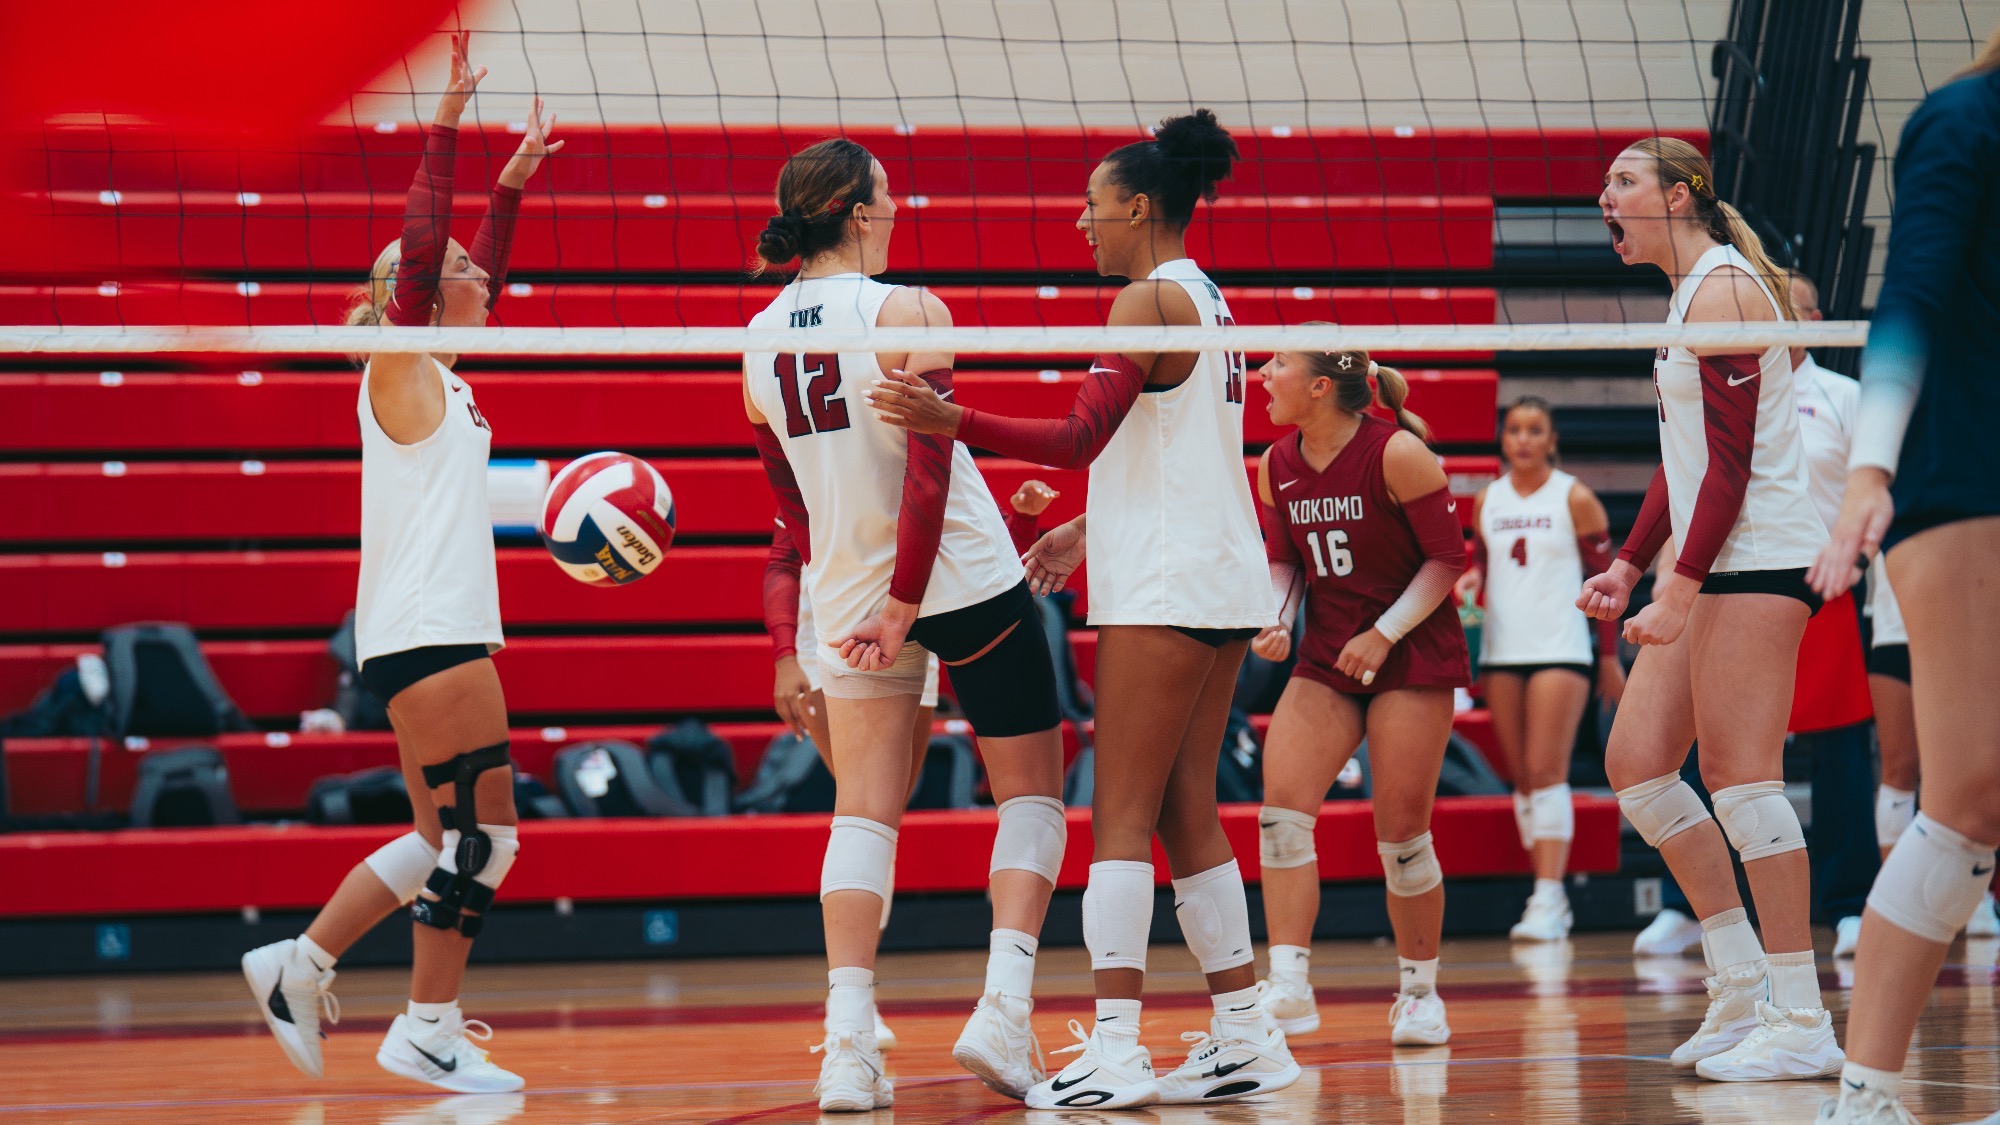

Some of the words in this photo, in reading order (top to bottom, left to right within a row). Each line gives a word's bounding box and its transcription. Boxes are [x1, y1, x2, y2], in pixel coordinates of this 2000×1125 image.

[789, 304, 823, 328] IUK
[774, 351, 850, 438] 12
[1288, 495, 1364, 525] KOKOMO
[616, 525, 656, 566] Baden
[1306, 529, 1354, 577] 16
[1510, 536, 1527, 567] 4
